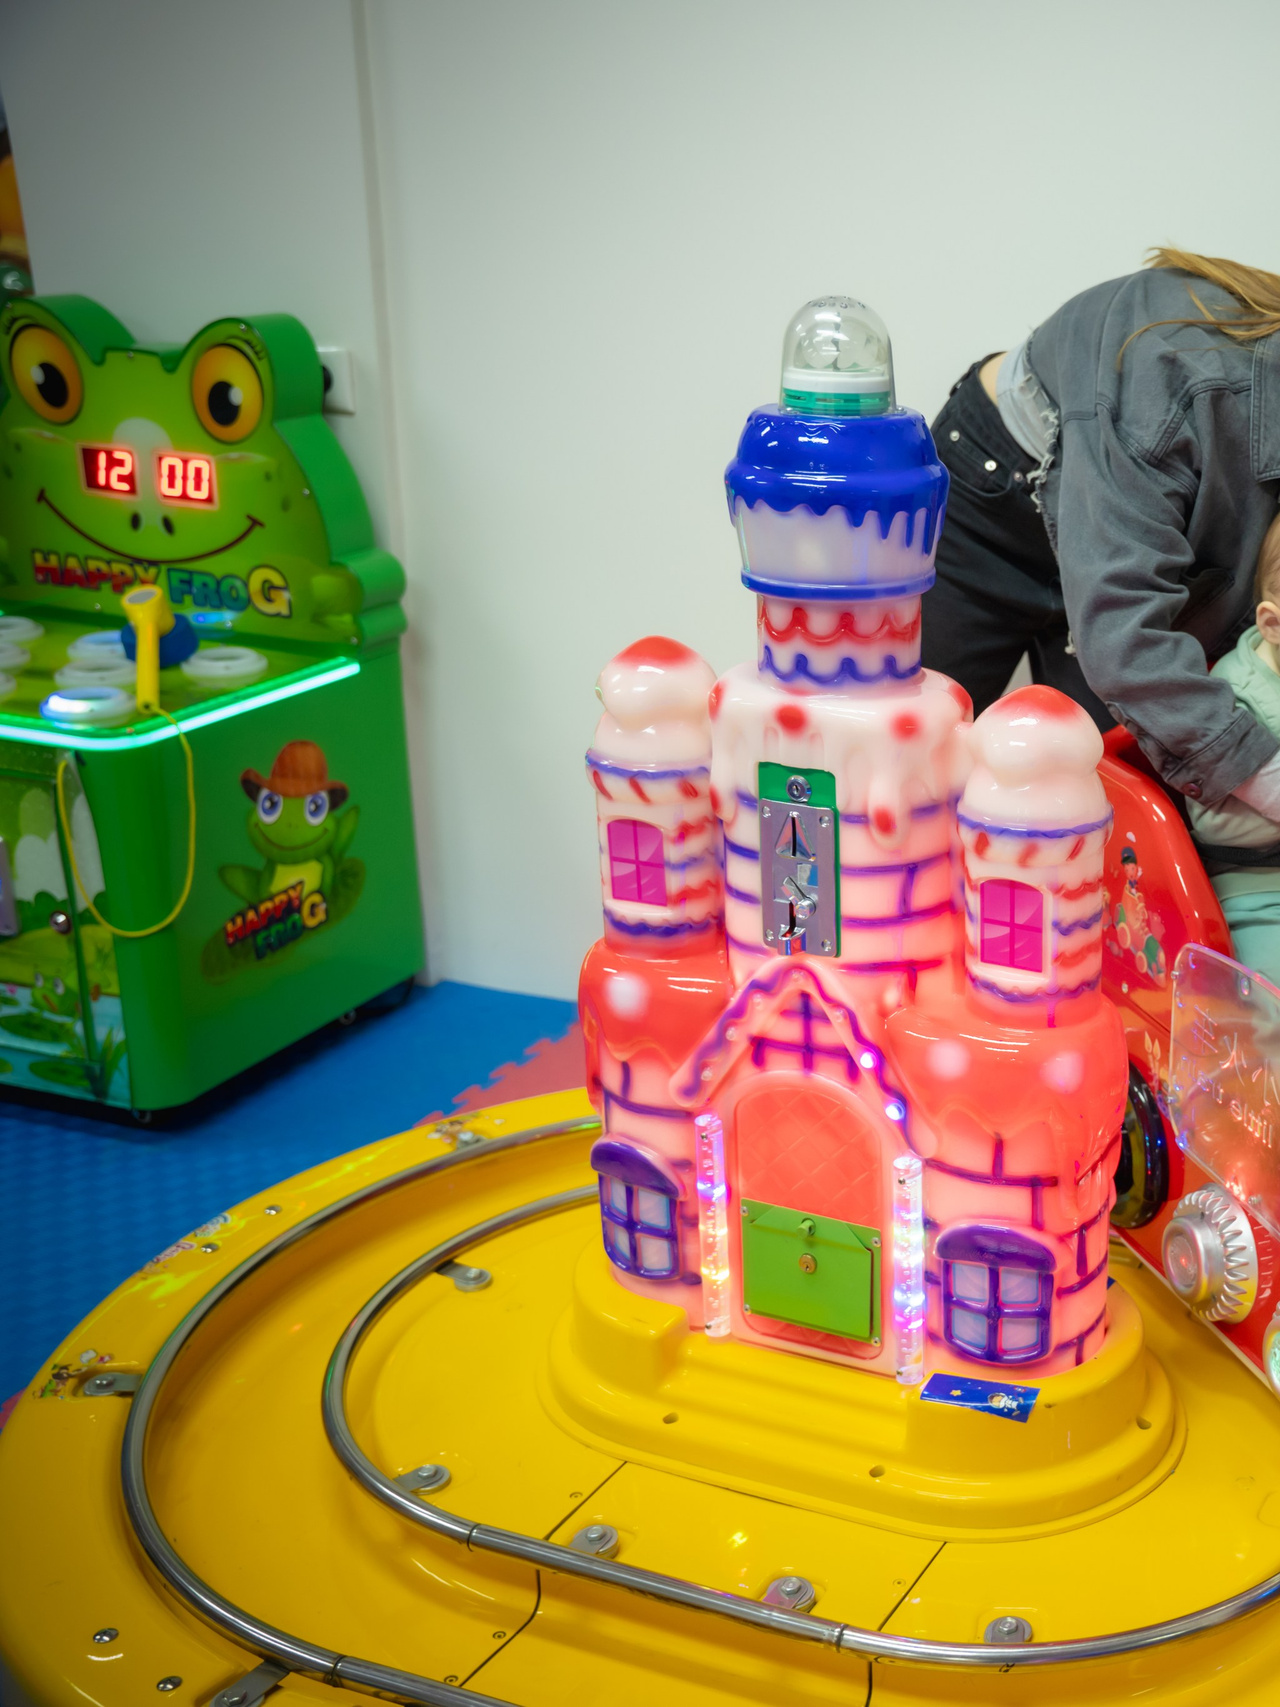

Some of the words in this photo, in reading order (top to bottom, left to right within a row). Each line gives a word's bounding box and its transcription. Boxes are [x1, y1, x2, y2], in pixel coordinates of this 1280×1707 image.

[97, 450, 133, 491] 12
[160, 456, 210, 500] 00
[32, 548, 160, 594] HAPPY
[167, 564, 293, 618] FROG
[225, 880, 304, 948] HAPPY
[254, 890, 328, 960] FROG
